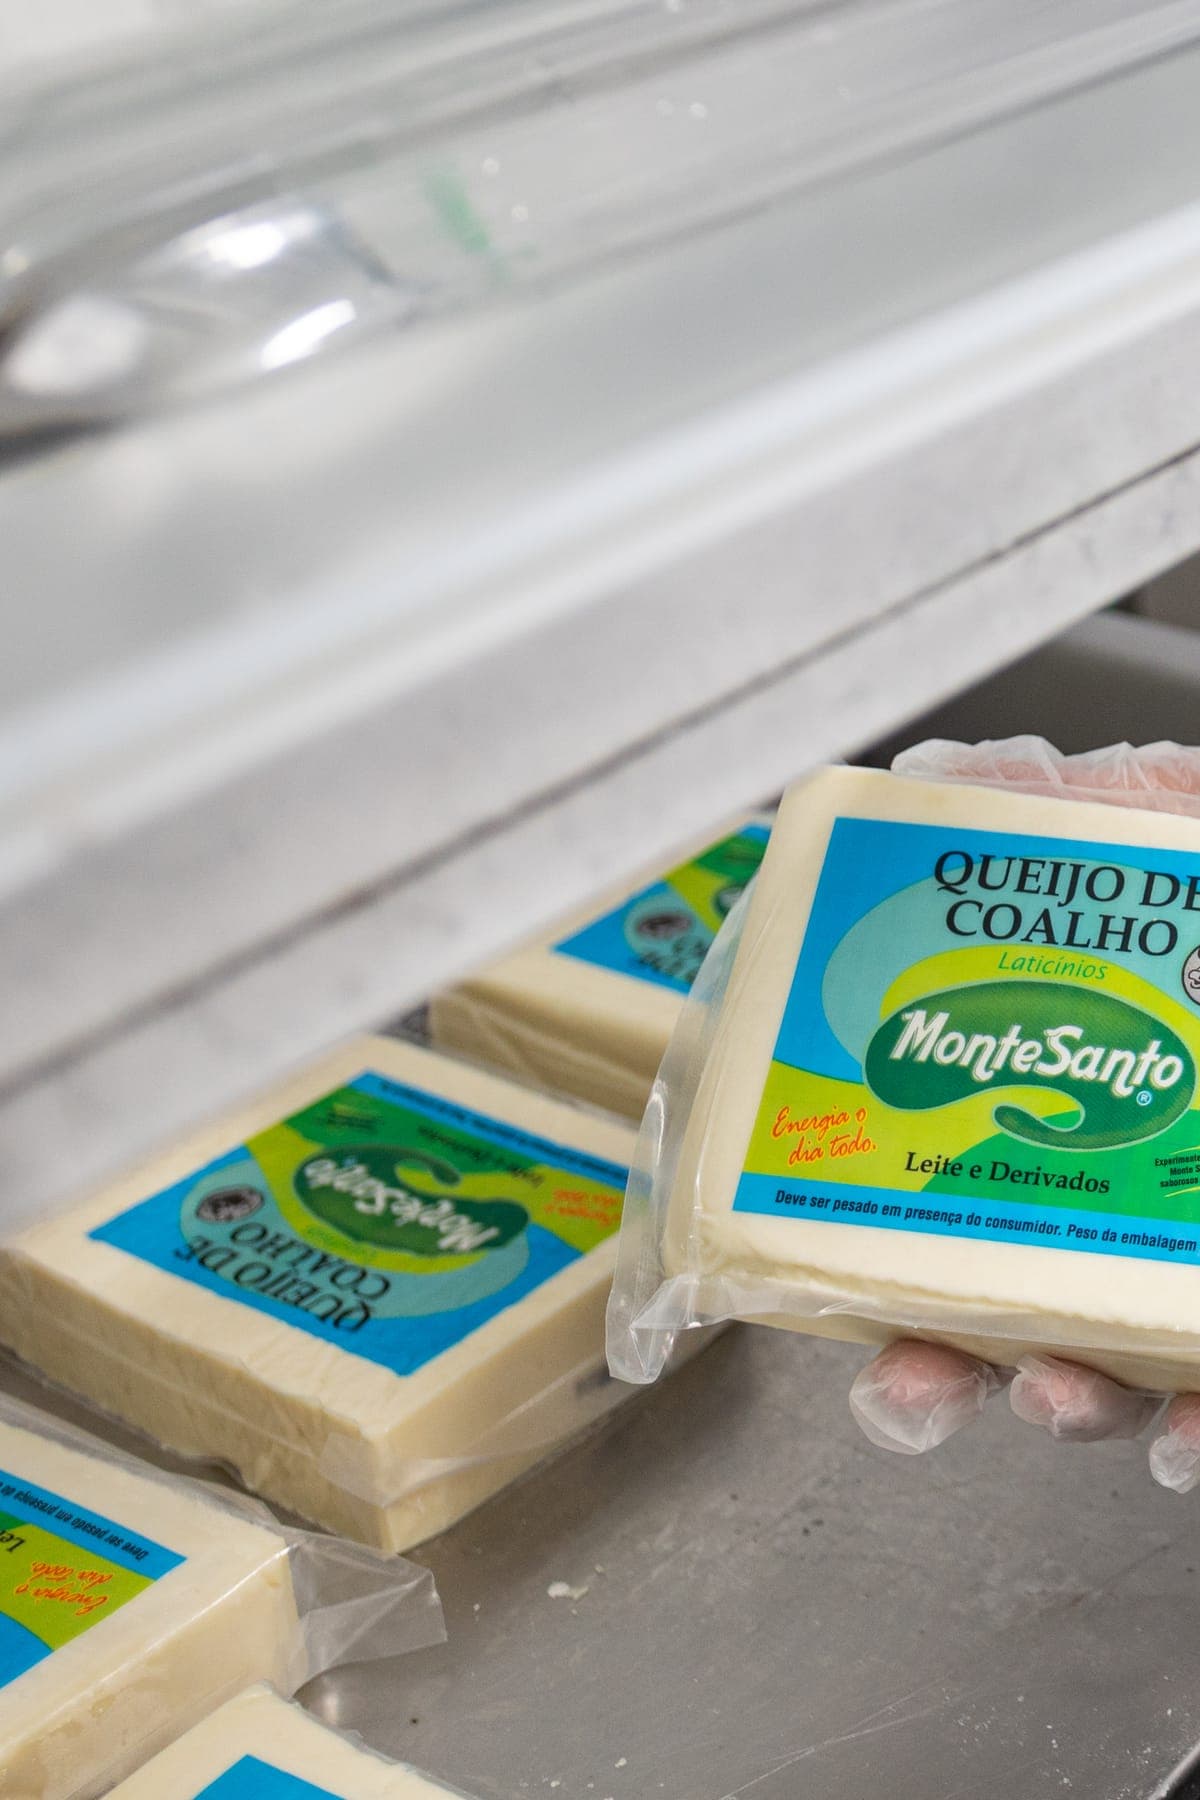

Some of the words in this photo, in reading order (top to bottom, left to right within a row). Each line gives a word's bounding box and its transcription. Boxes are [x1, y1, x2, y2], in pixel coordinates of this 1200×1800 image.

[934, 850, 1126, 907] QUEIJO
[945, 899, 1178, 956] COALHO
[997, 952, 1108, 980] Laticínios
[772, 1105, 850, 1141] Energia
[855, 1107, 867, 1122] o
[788, 1136, 824, 1166] dia
[830, 1126, 877, 1158] todo.
[904, 1151, 963, 1177] Leite
[969, 1163, 982, 1180] e
[988, 1161, 1111, 1194] Derivados
[1160, 1177, 1199, 1188] saborosos
[1169, 1166, 1194, 1176] Monte
[775, 1189, 807, 1206] Deve
[809, 1196, 835, 1209] ser
[832, 1197, 878, 1215] pesado
[881, 1205, 901, 1217] em
[904, 1209, 962, 1227] presença
[966, 1211, 982, 1226] do
[984, 1215, 1062, 1236] consumidor.
[1066, 1223, 1098, 1240] Peso
[1101, 1228, 1117, 1243] da
[1120, 1231, 1197, 1252] embalagem
[172, 1234, 240, 1273] DE
[229, 1221, 391, 1301] COALHO
[232, 1260, 372, 1334] QUEIJO
[54, 1508, 74, 1523] em
[71, 1517, 109, 1540] pesado
[104, 1534, 125, 1548] ser
[121, 1543, 149, 1561] Deve
[77, 1568, 114, 1592] dia
[30, 1582, 109, 1617] Energia
